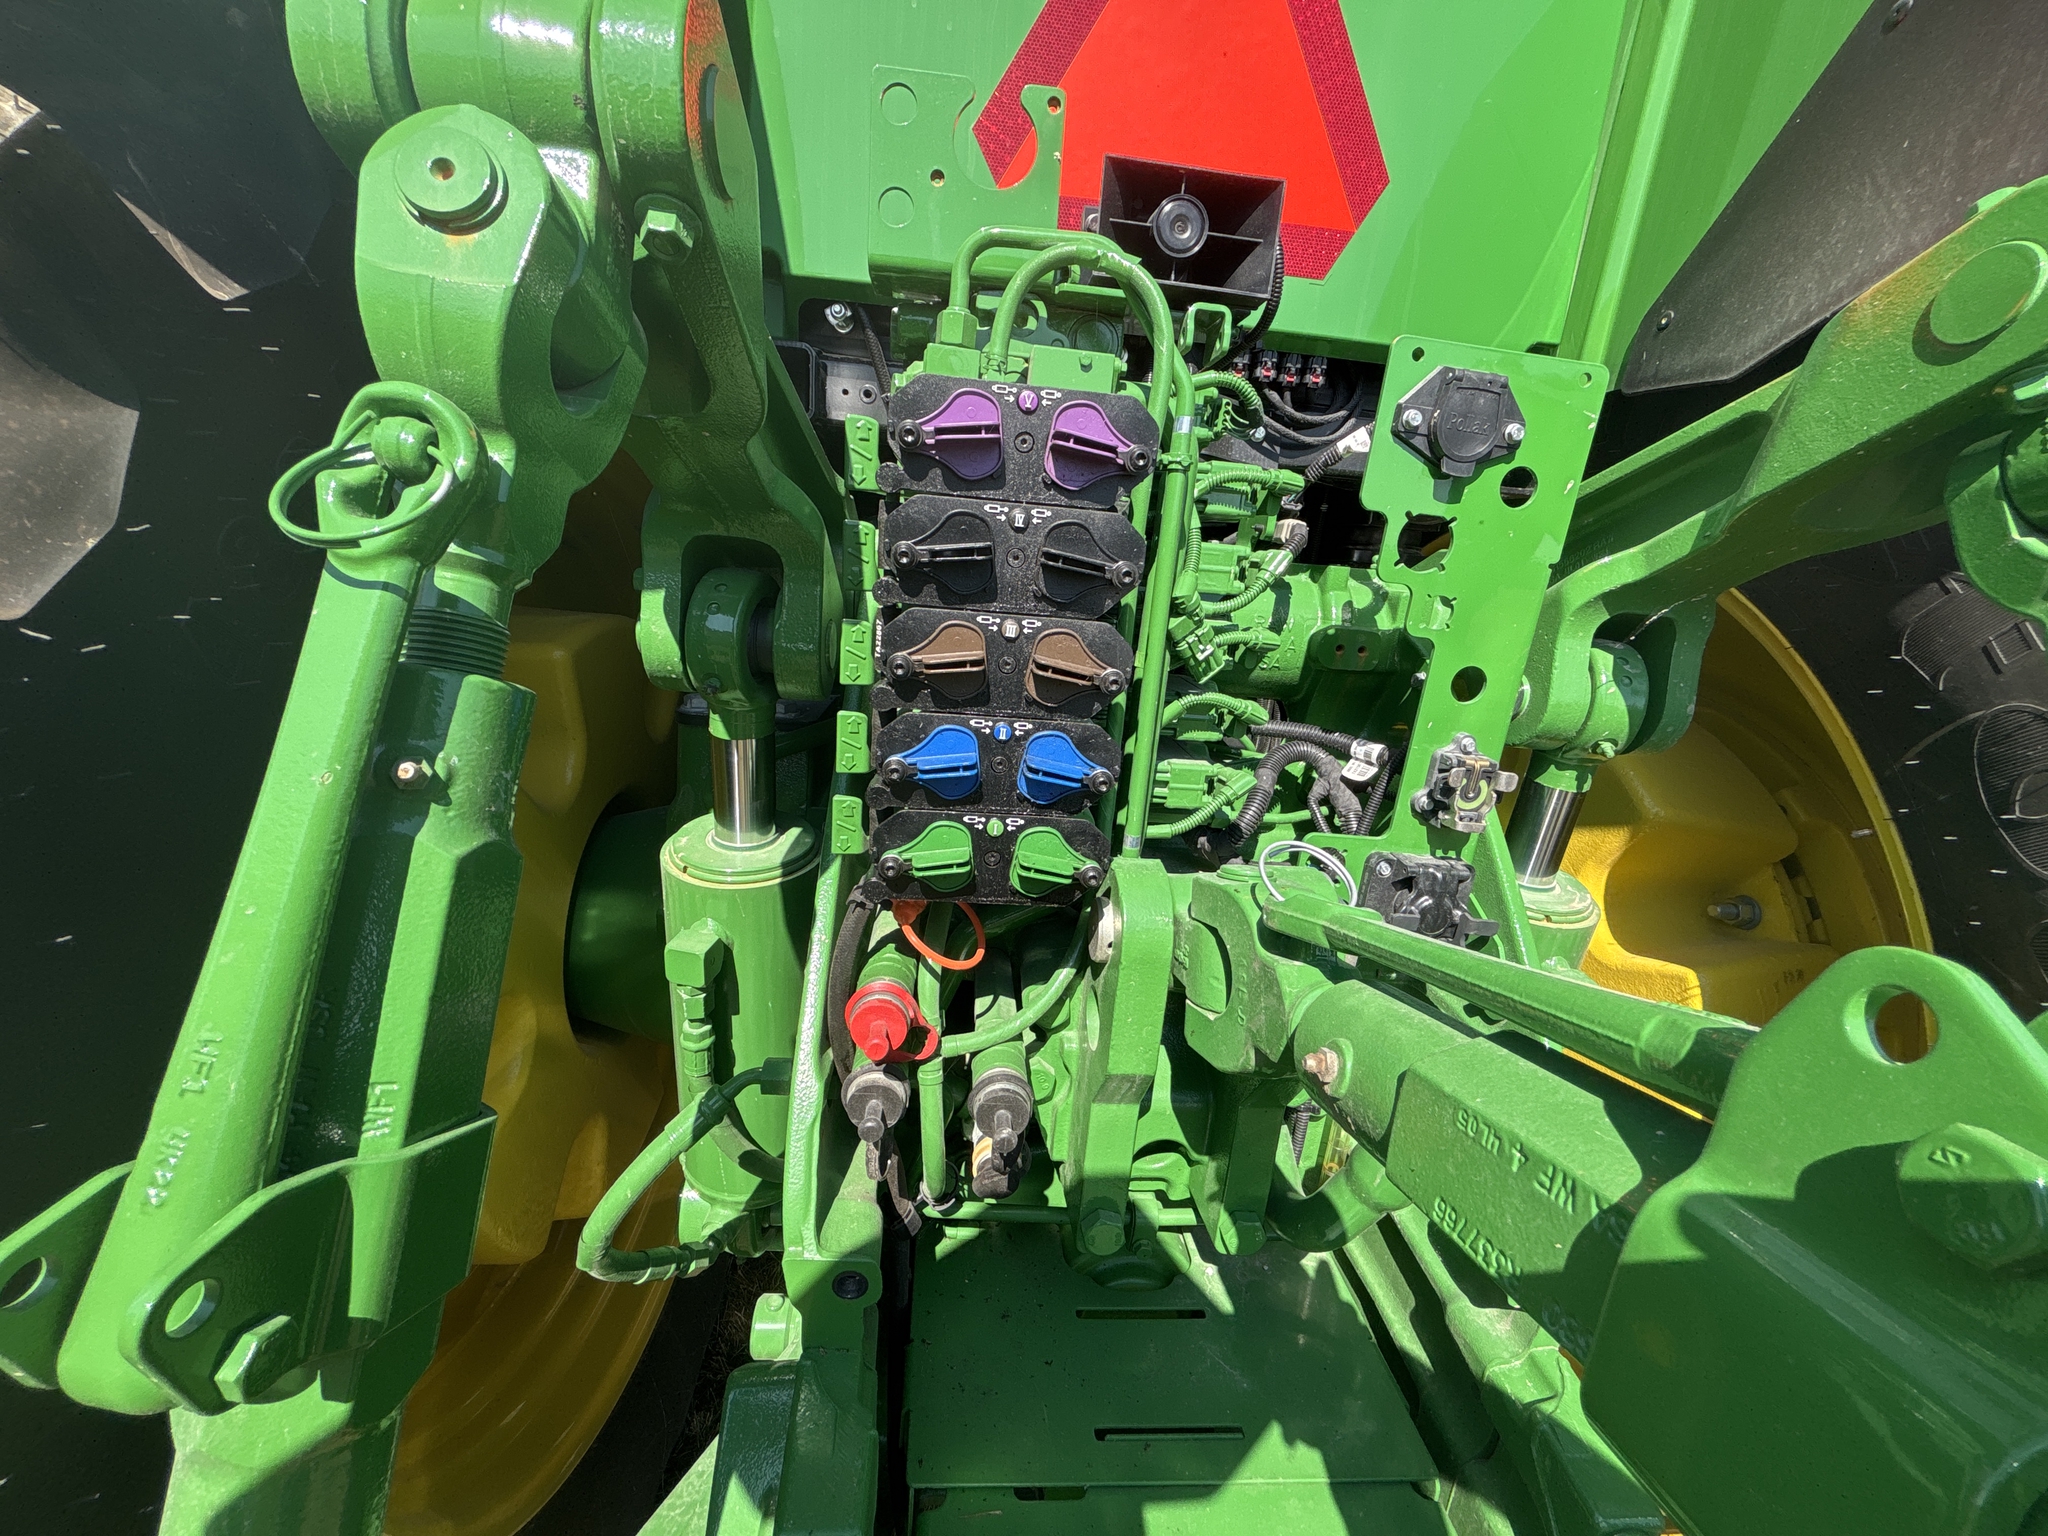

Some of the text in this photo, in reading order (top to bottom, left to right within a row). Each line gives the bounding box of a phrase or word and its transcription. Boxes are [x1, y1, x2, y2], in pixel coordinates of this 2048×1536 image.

[1023, 393, 1035, 408] V
[1446, 411, 1491, 437] Pollak
[1014, 513, 1025, 528] IV
[1004, 624, 1017, 637] III
[998, 727, 1008, 740] II
